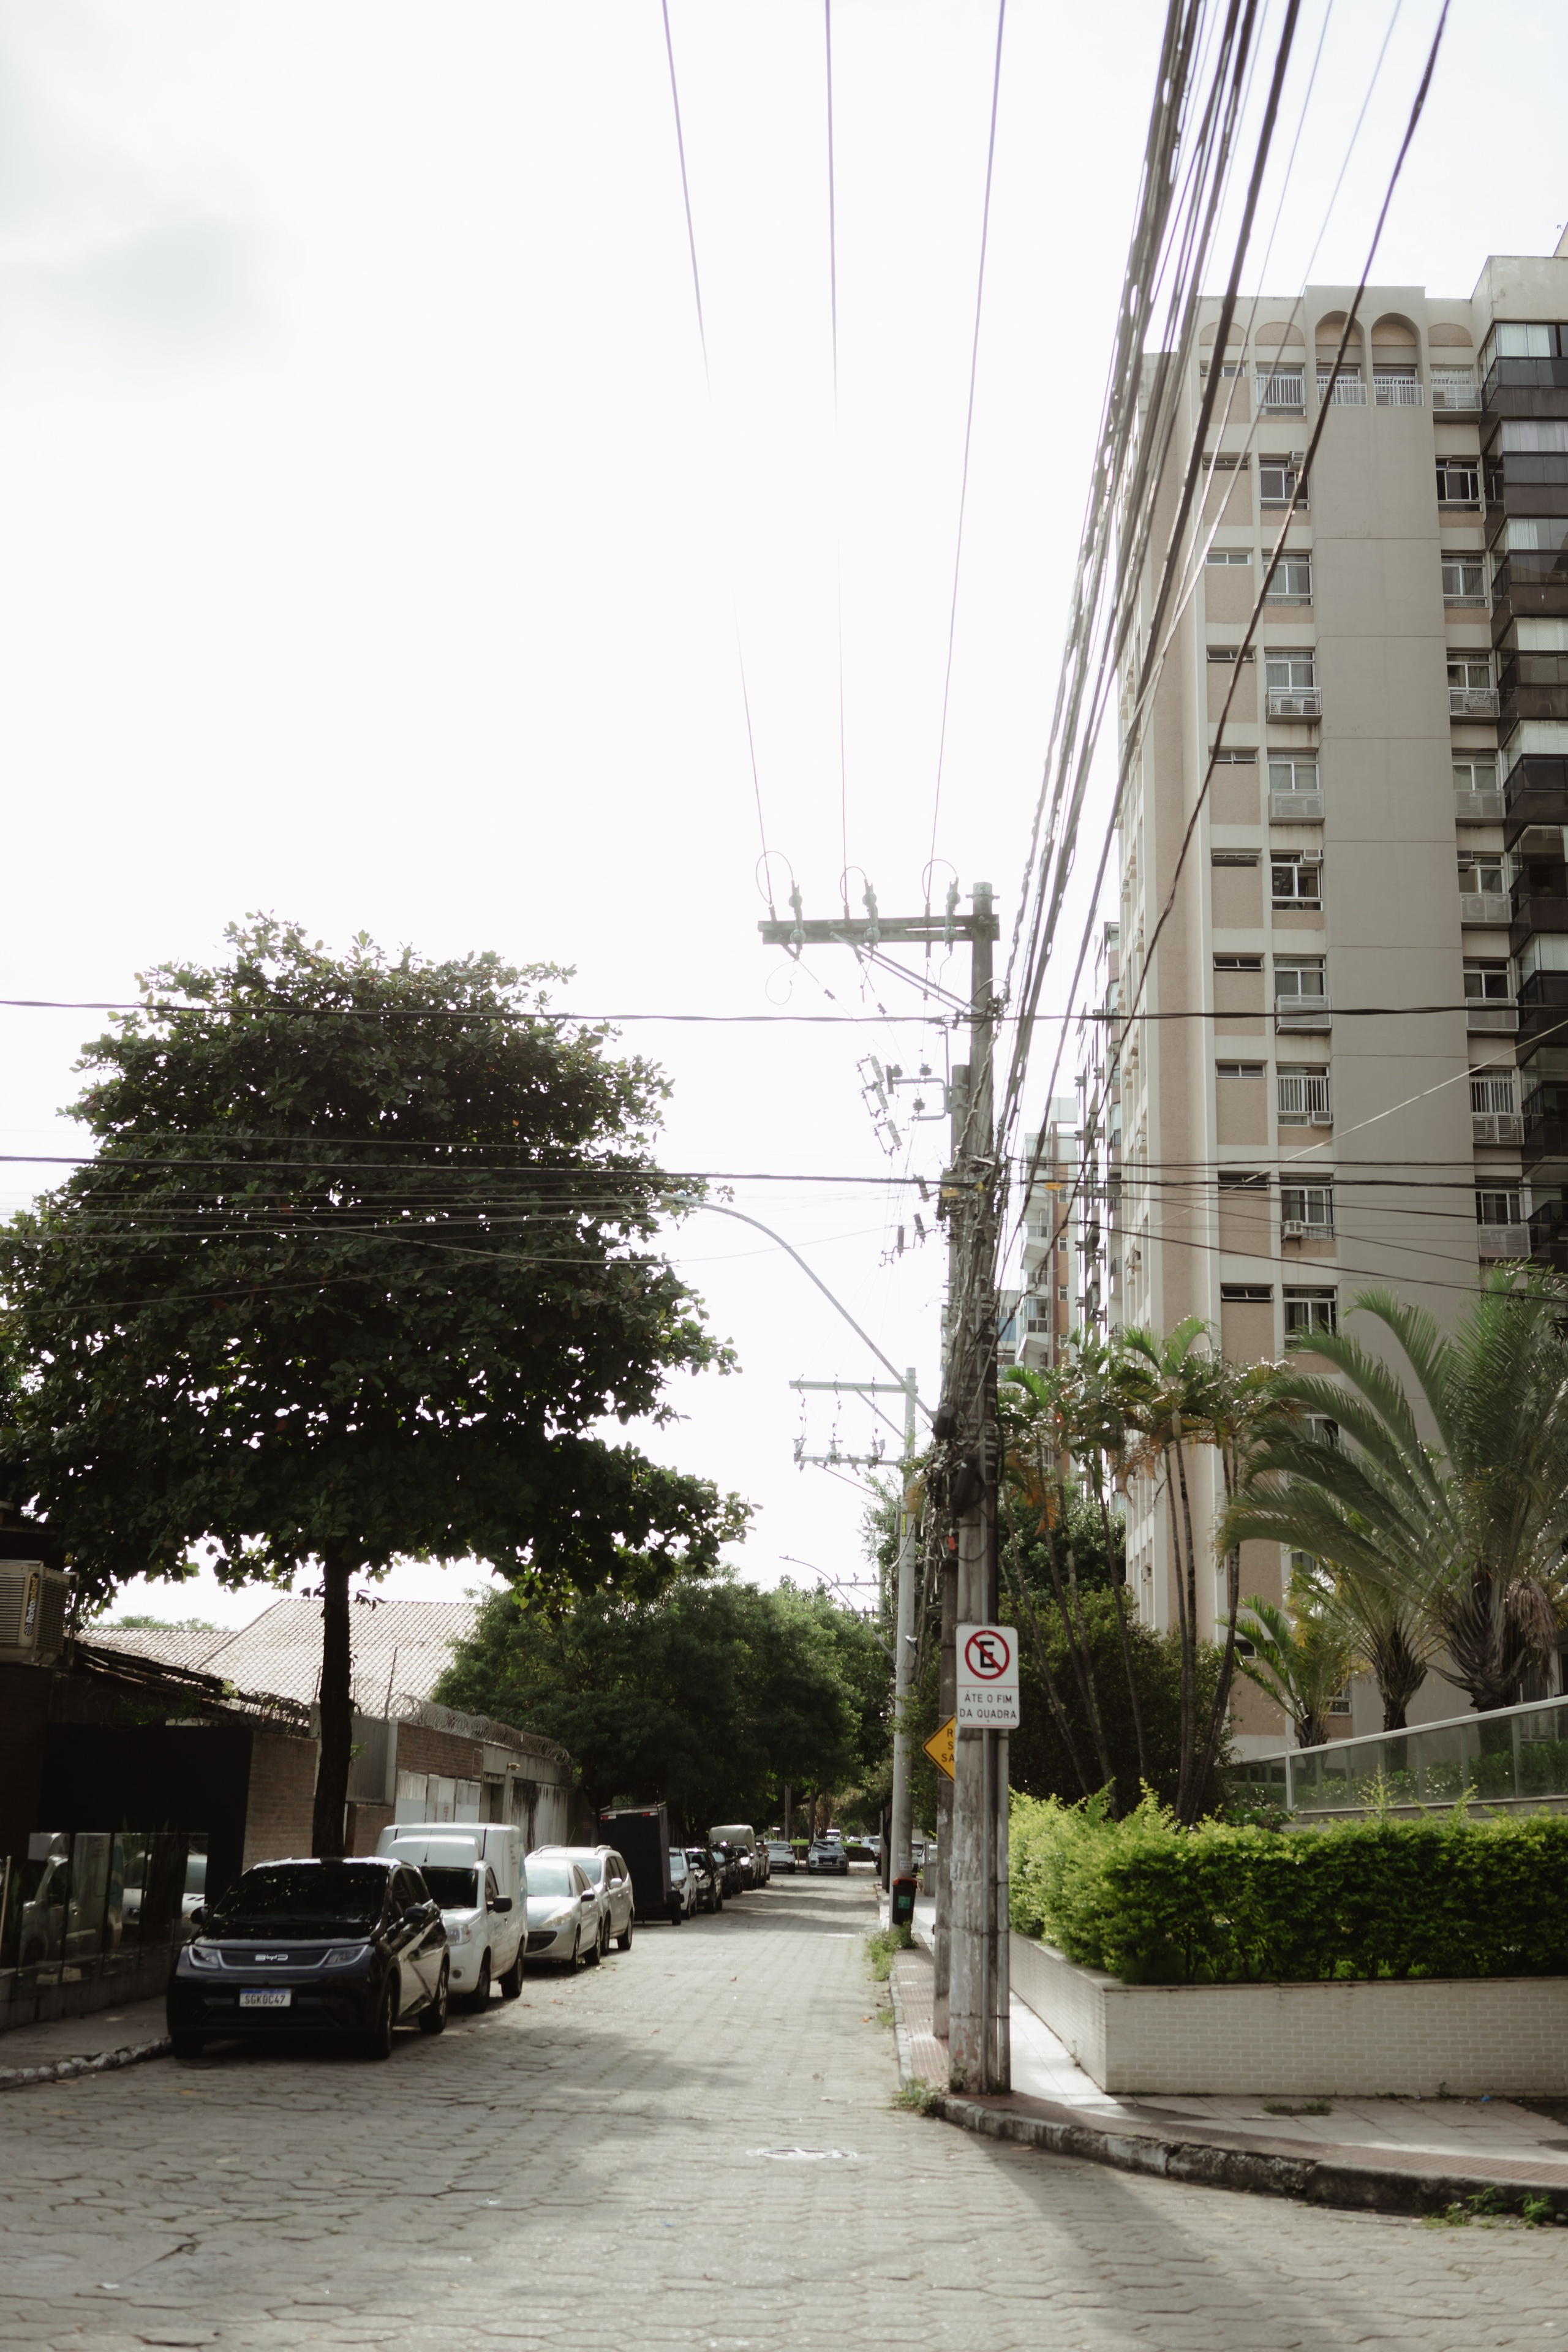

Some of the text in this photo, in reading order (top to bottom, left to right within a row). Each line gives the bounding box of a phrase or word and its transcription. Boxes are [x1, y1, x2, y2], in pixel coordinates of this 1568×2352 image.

[26, 1576, 39, 1624] Rotoplast
[979, 1641, 995, 1668] E
[987, 1694, 993, 1703] O
[997, 1694, 1012, 1703] FIM
[960, 1709, 1017, 1719] DA QUADRA
[947, 1728, 954, 1738] R
[948, 1741, 954, 1751] S
[941, 1753, 955, 1762] SA
